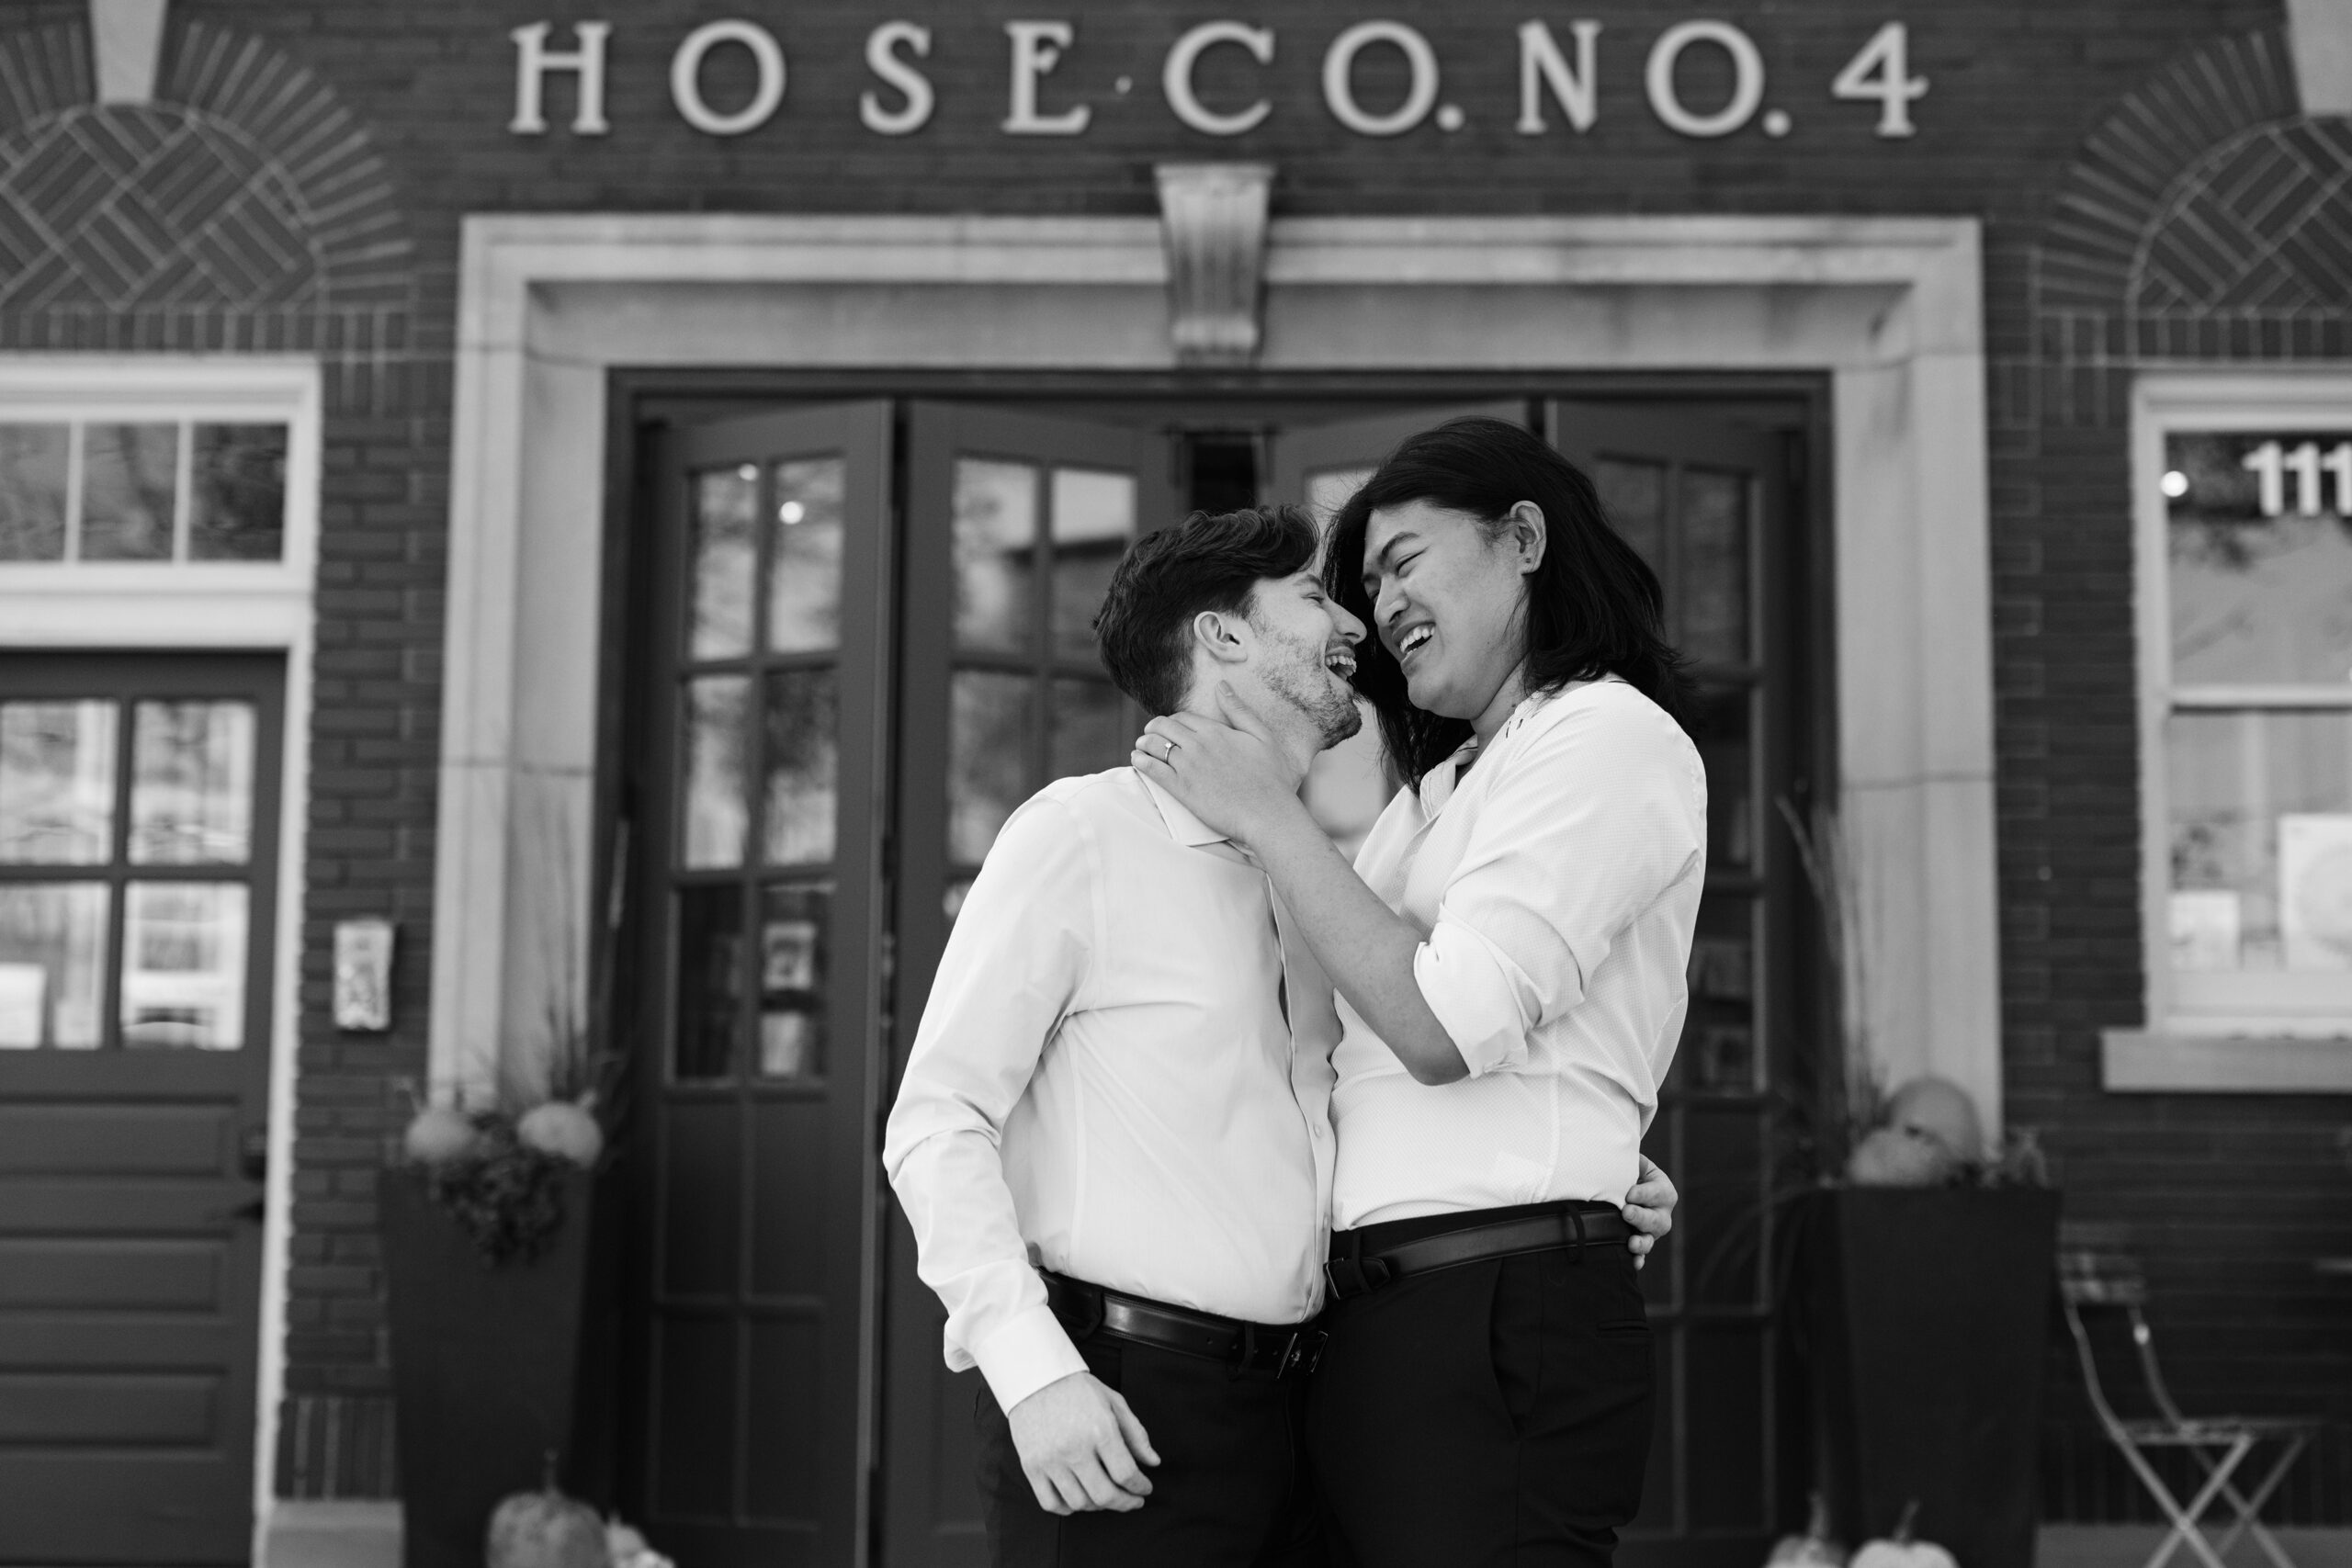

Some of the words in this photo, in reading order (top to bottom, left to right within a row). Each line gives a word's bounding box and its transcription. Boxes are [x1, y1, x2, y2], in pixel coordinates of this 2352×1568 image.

[507, 18, 1091, 135] HOSE
[1161, 19, 1465, 136] CO.
[1516, 19, 1792, 137] NO.
[1831, 20, 1930, 137] 4
